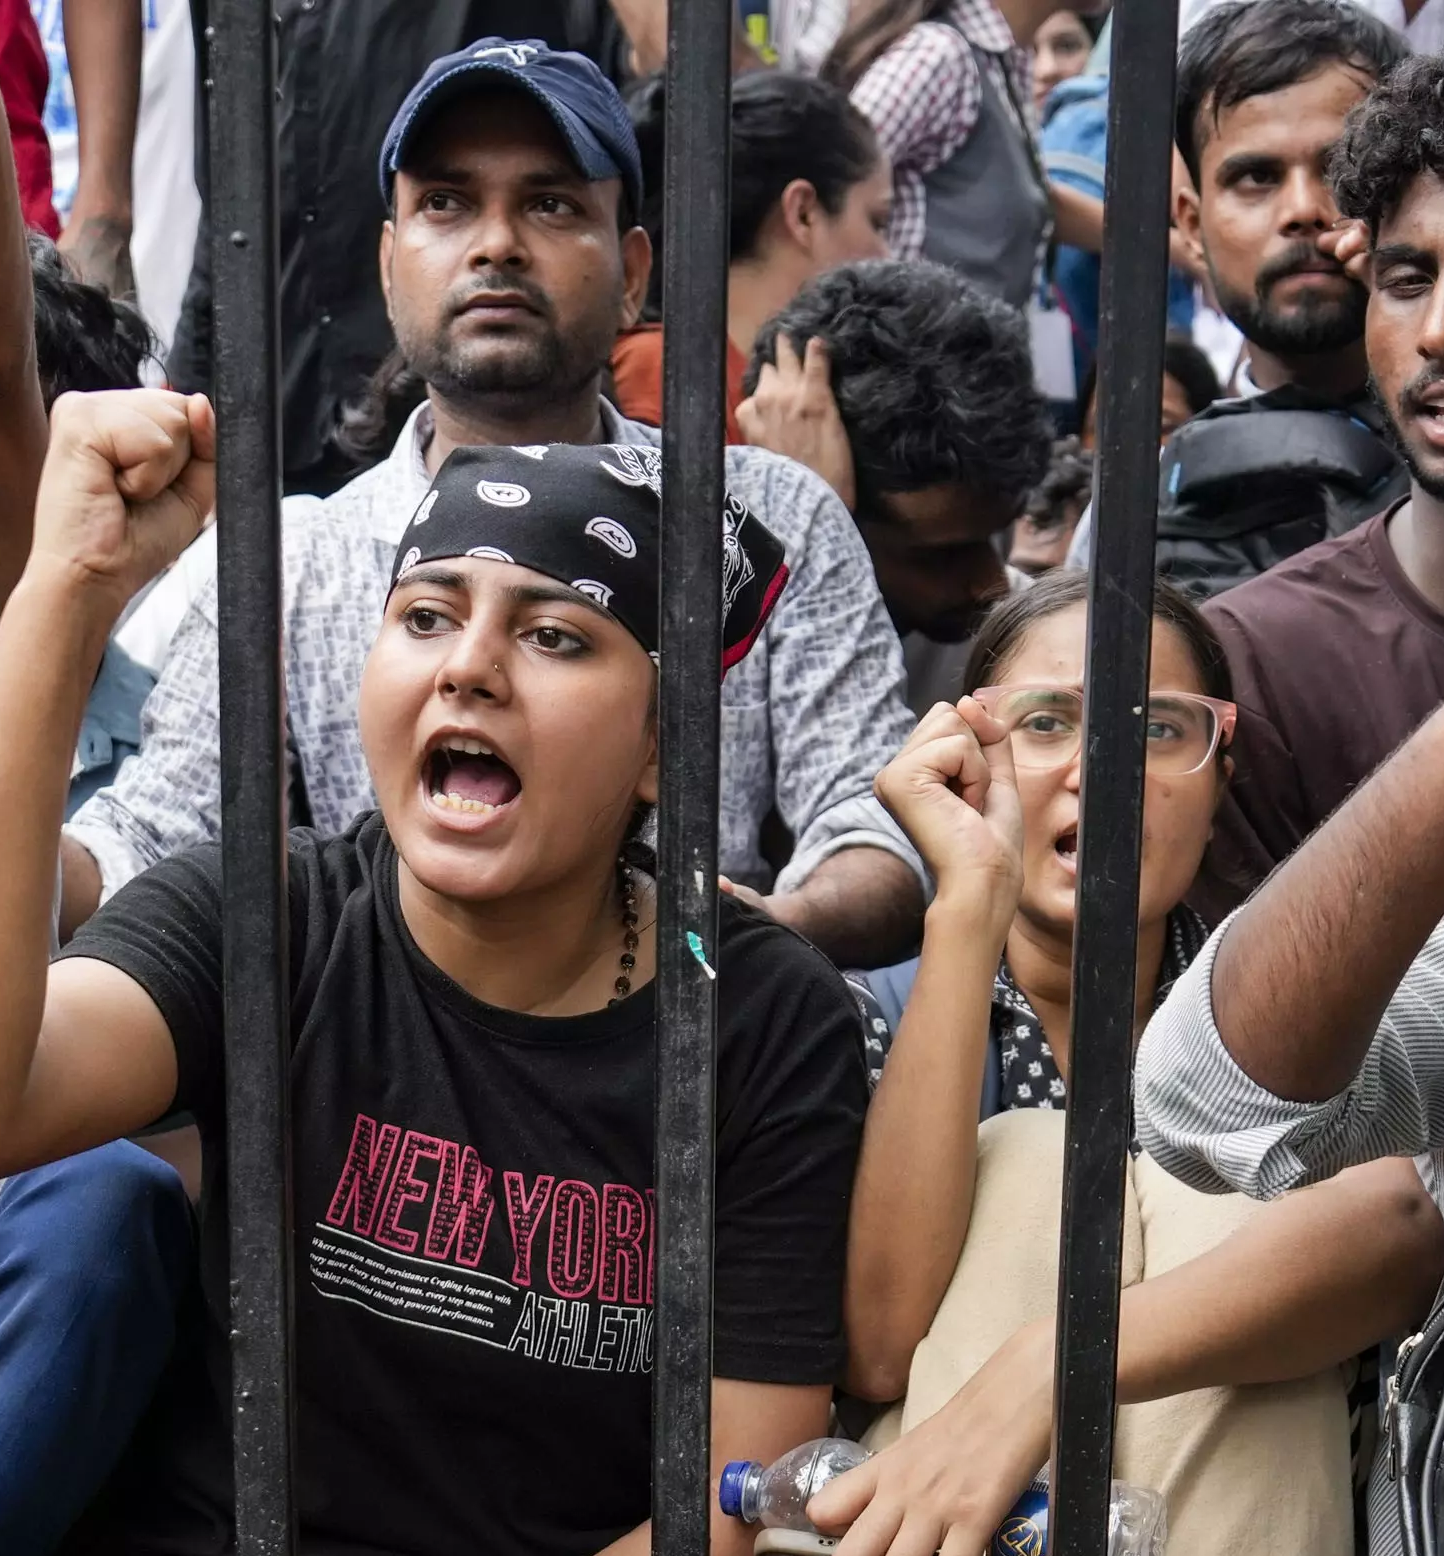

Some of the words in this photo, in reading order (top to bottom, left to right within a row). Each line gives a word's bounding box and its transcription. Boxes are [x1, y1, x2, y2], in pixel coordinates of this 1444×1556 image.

[325, 1113, 495, 1267] NEW
[503, 1170, 655, 1305] YOR
[311, 1237, 337, 1252] Where
[334, 1247, 365, 1262] passion
[365, 1258, 386, 1271] meets
[430, 1276, 463, 1293] Crafting
[463, 1284, 494, 1299] legends
[494, 1294, 512, 1306] with
[327, 1259, 349, 1270] move
[348, 1263, 370, 1280] Every
[369, 1275, 397, 1289] second
[425, 1290, 448, 1303] every
[447, 1296, 465, 1307] step
[340, 1276, 374, 1297] potential
[372, 1290, 405, 1306] through
[403, 1300, 442, 1314] powerful
[439, 1309, 495, 1329] performances
